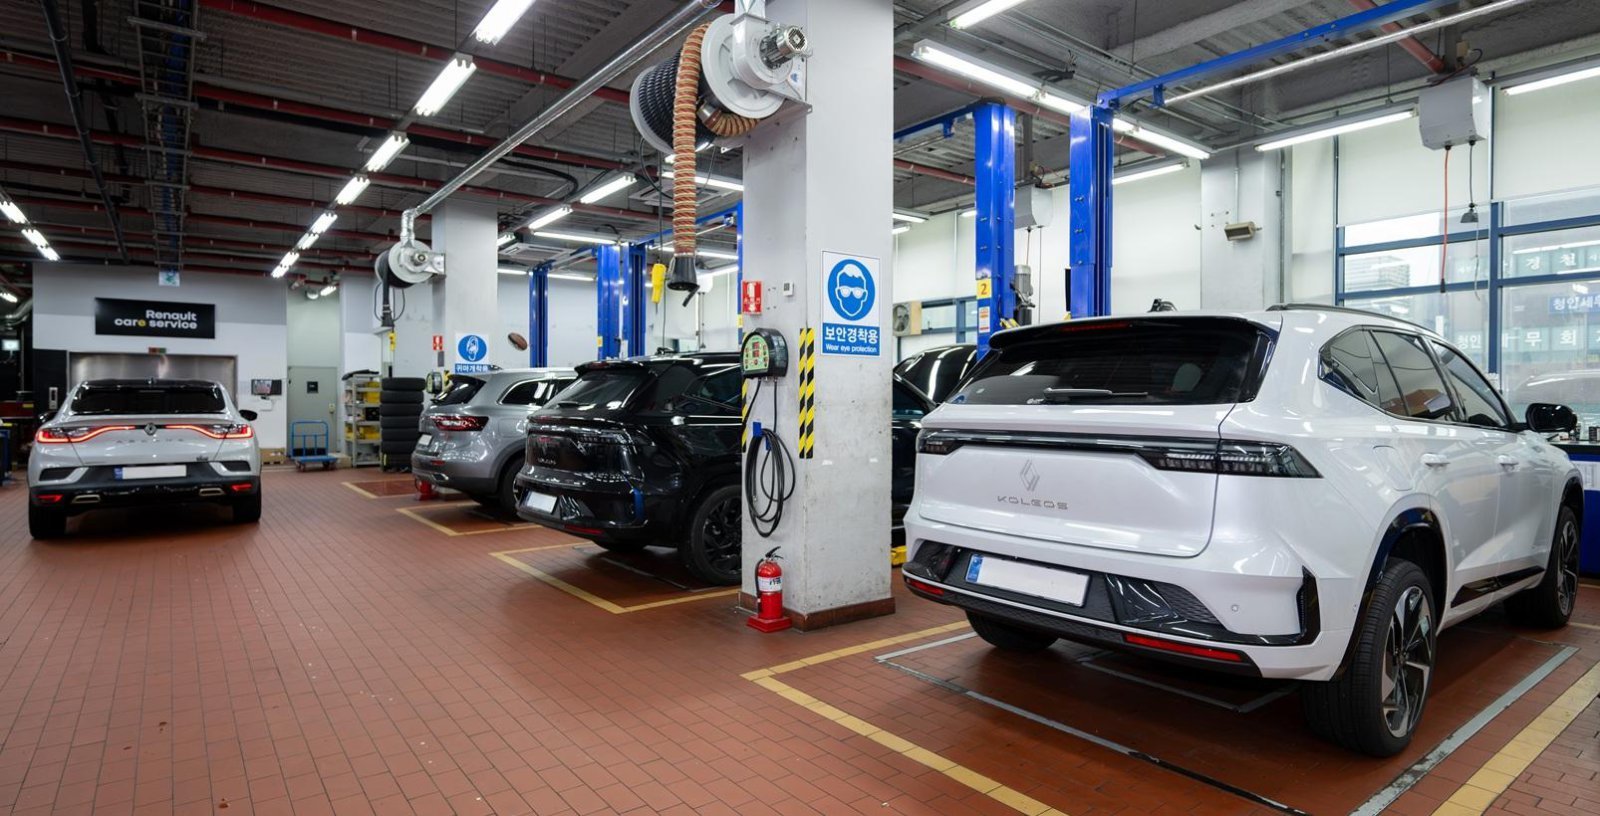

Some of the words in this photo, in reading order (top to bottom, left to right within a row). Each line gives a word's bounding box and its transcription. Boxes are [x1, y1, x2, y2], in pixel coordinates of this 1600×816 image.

[981, 283, 988, 295] 2
[146, 309, 197, 321] Renault
[114, 318, 146, 327] care
[149, 319, 198, 329] service
[825, 326, 878, 344] 보안경착용
[826, 343, 839, 351] Wear
[997, 495, 1068, 510] KOLEOS
